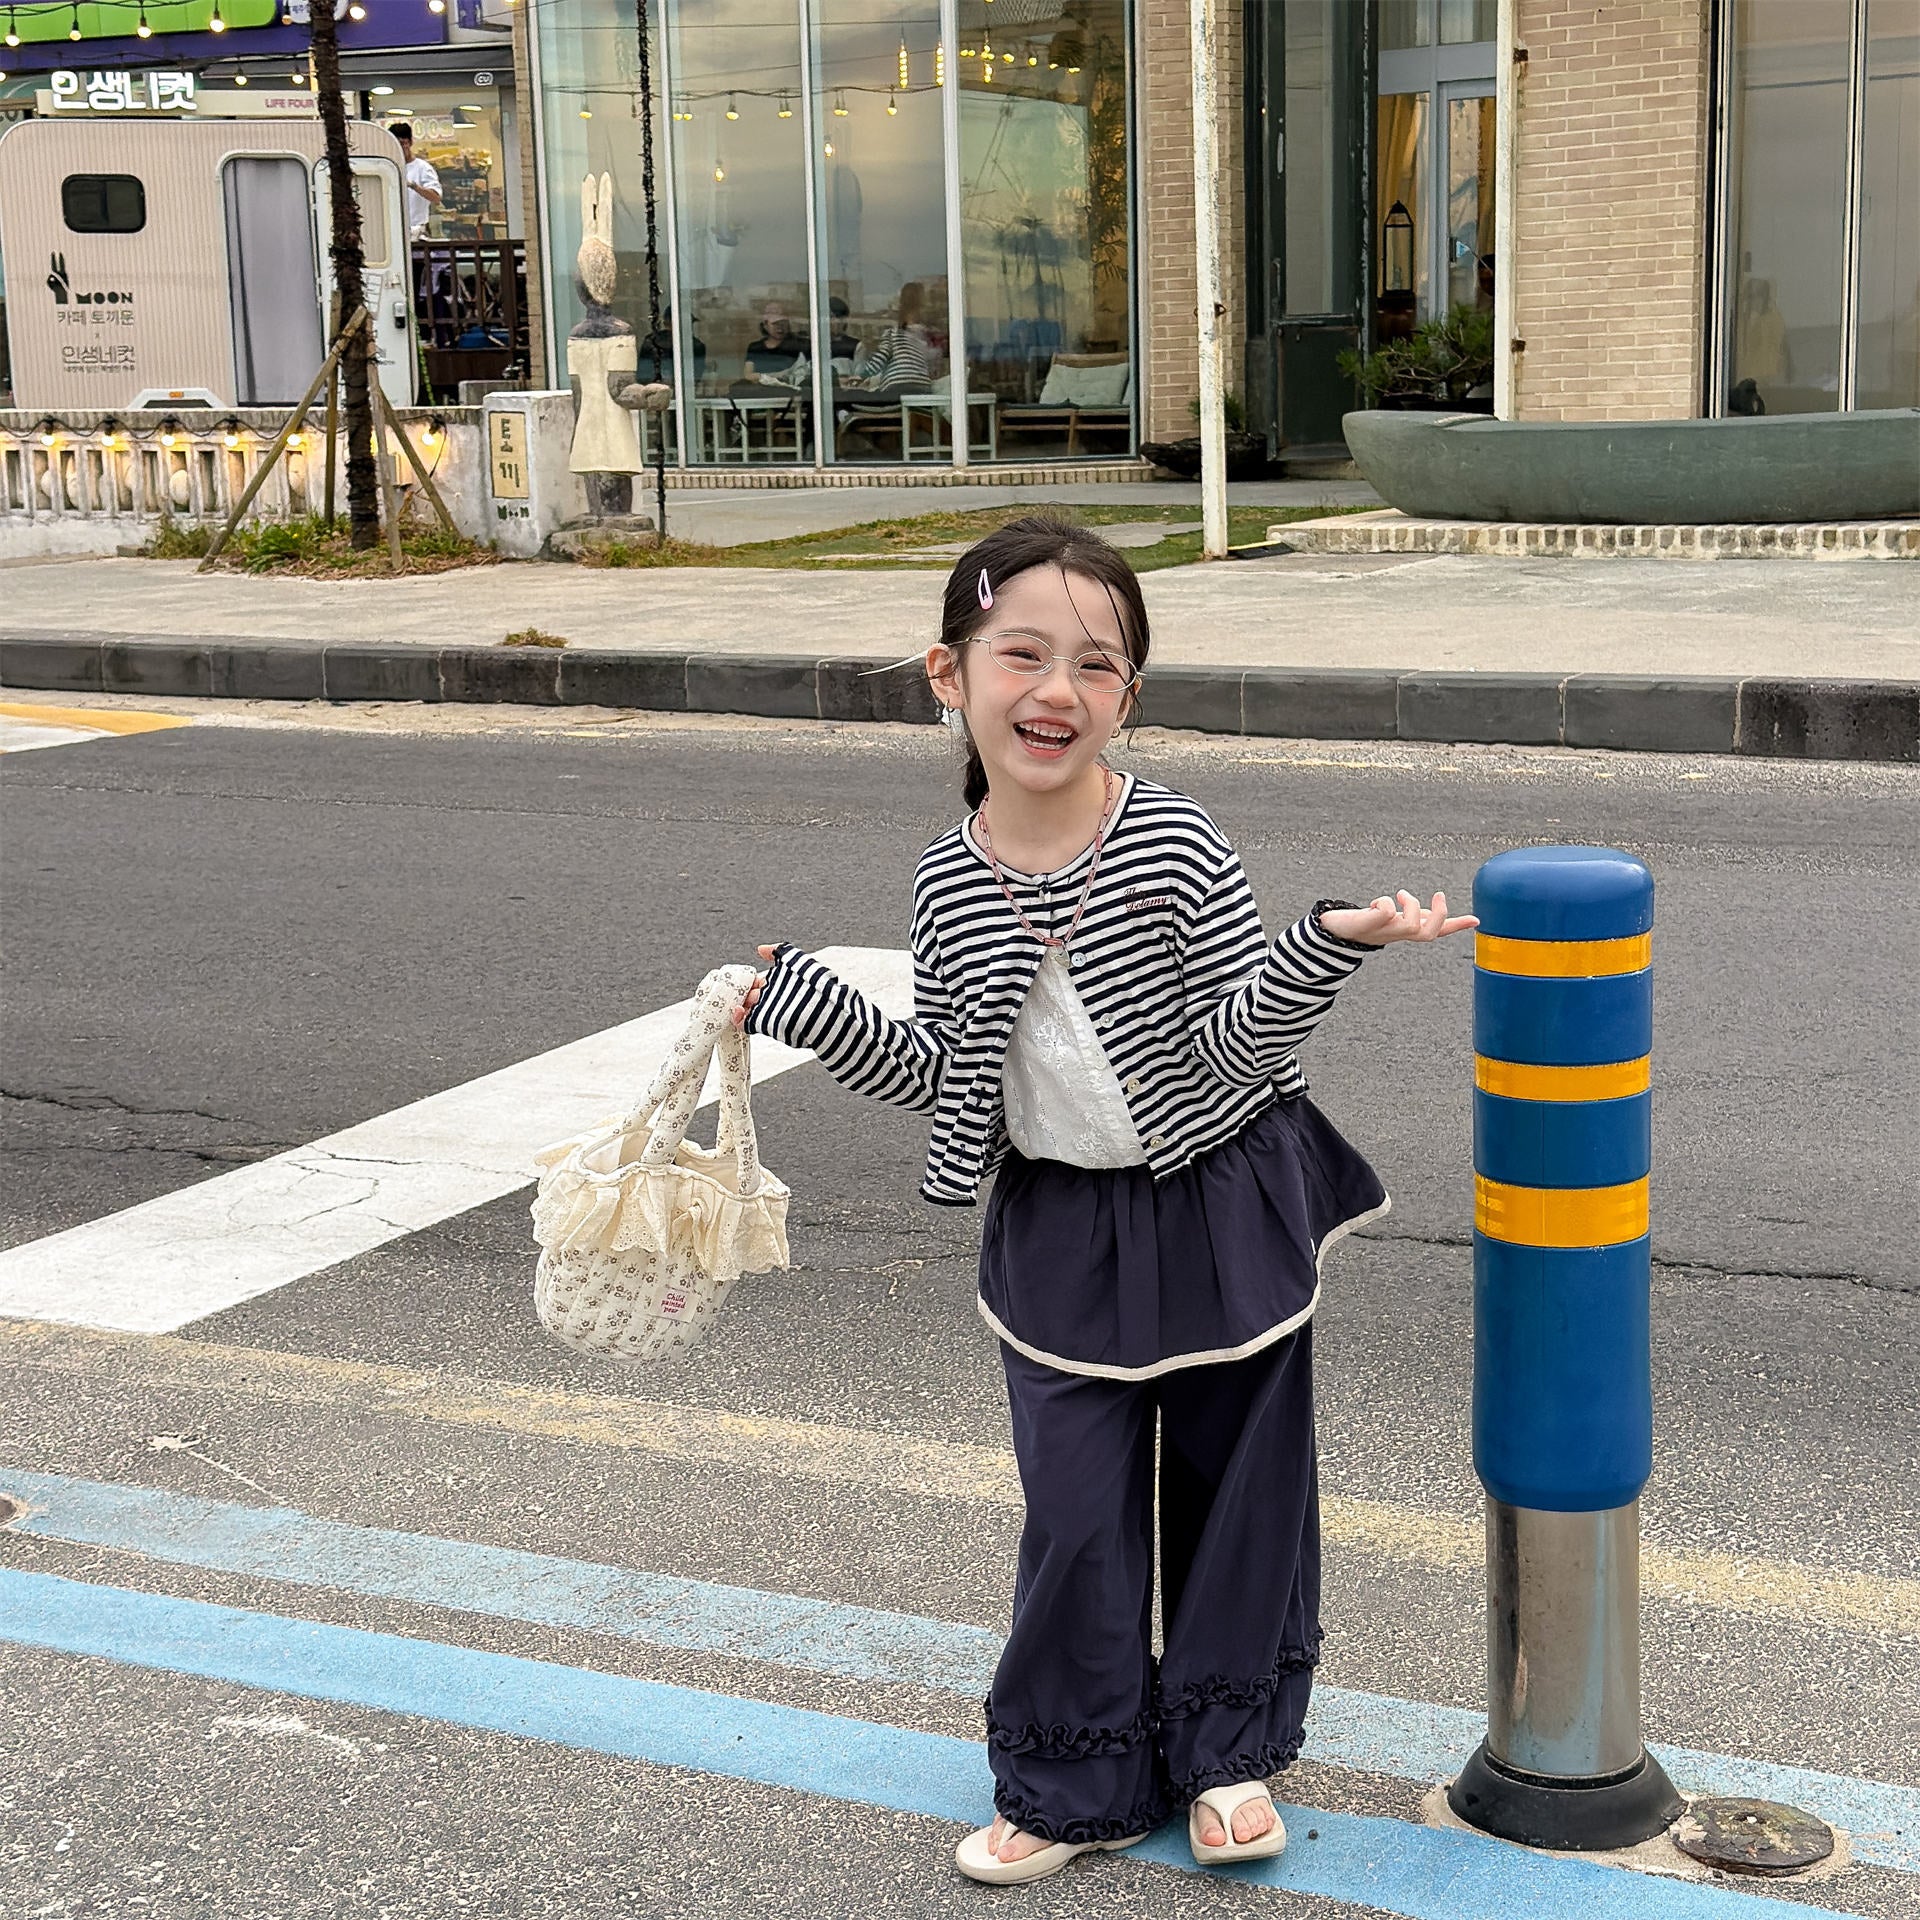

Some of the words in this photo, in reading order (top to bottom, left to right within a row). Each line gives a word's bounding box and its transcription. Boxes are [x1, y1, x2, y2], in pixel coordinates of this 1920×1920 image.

[51, 71, 198, 110] 인생네컷
[265, 98, 286, 108] LIFE
[288, 98, 315, 108] FOUR
[75, 291, 133, 304] MOON
[57, 310, 87, 325] 카페
[62, 345, 135, 364] 인생네컷
[667, 1293, 686, 1303] Child
